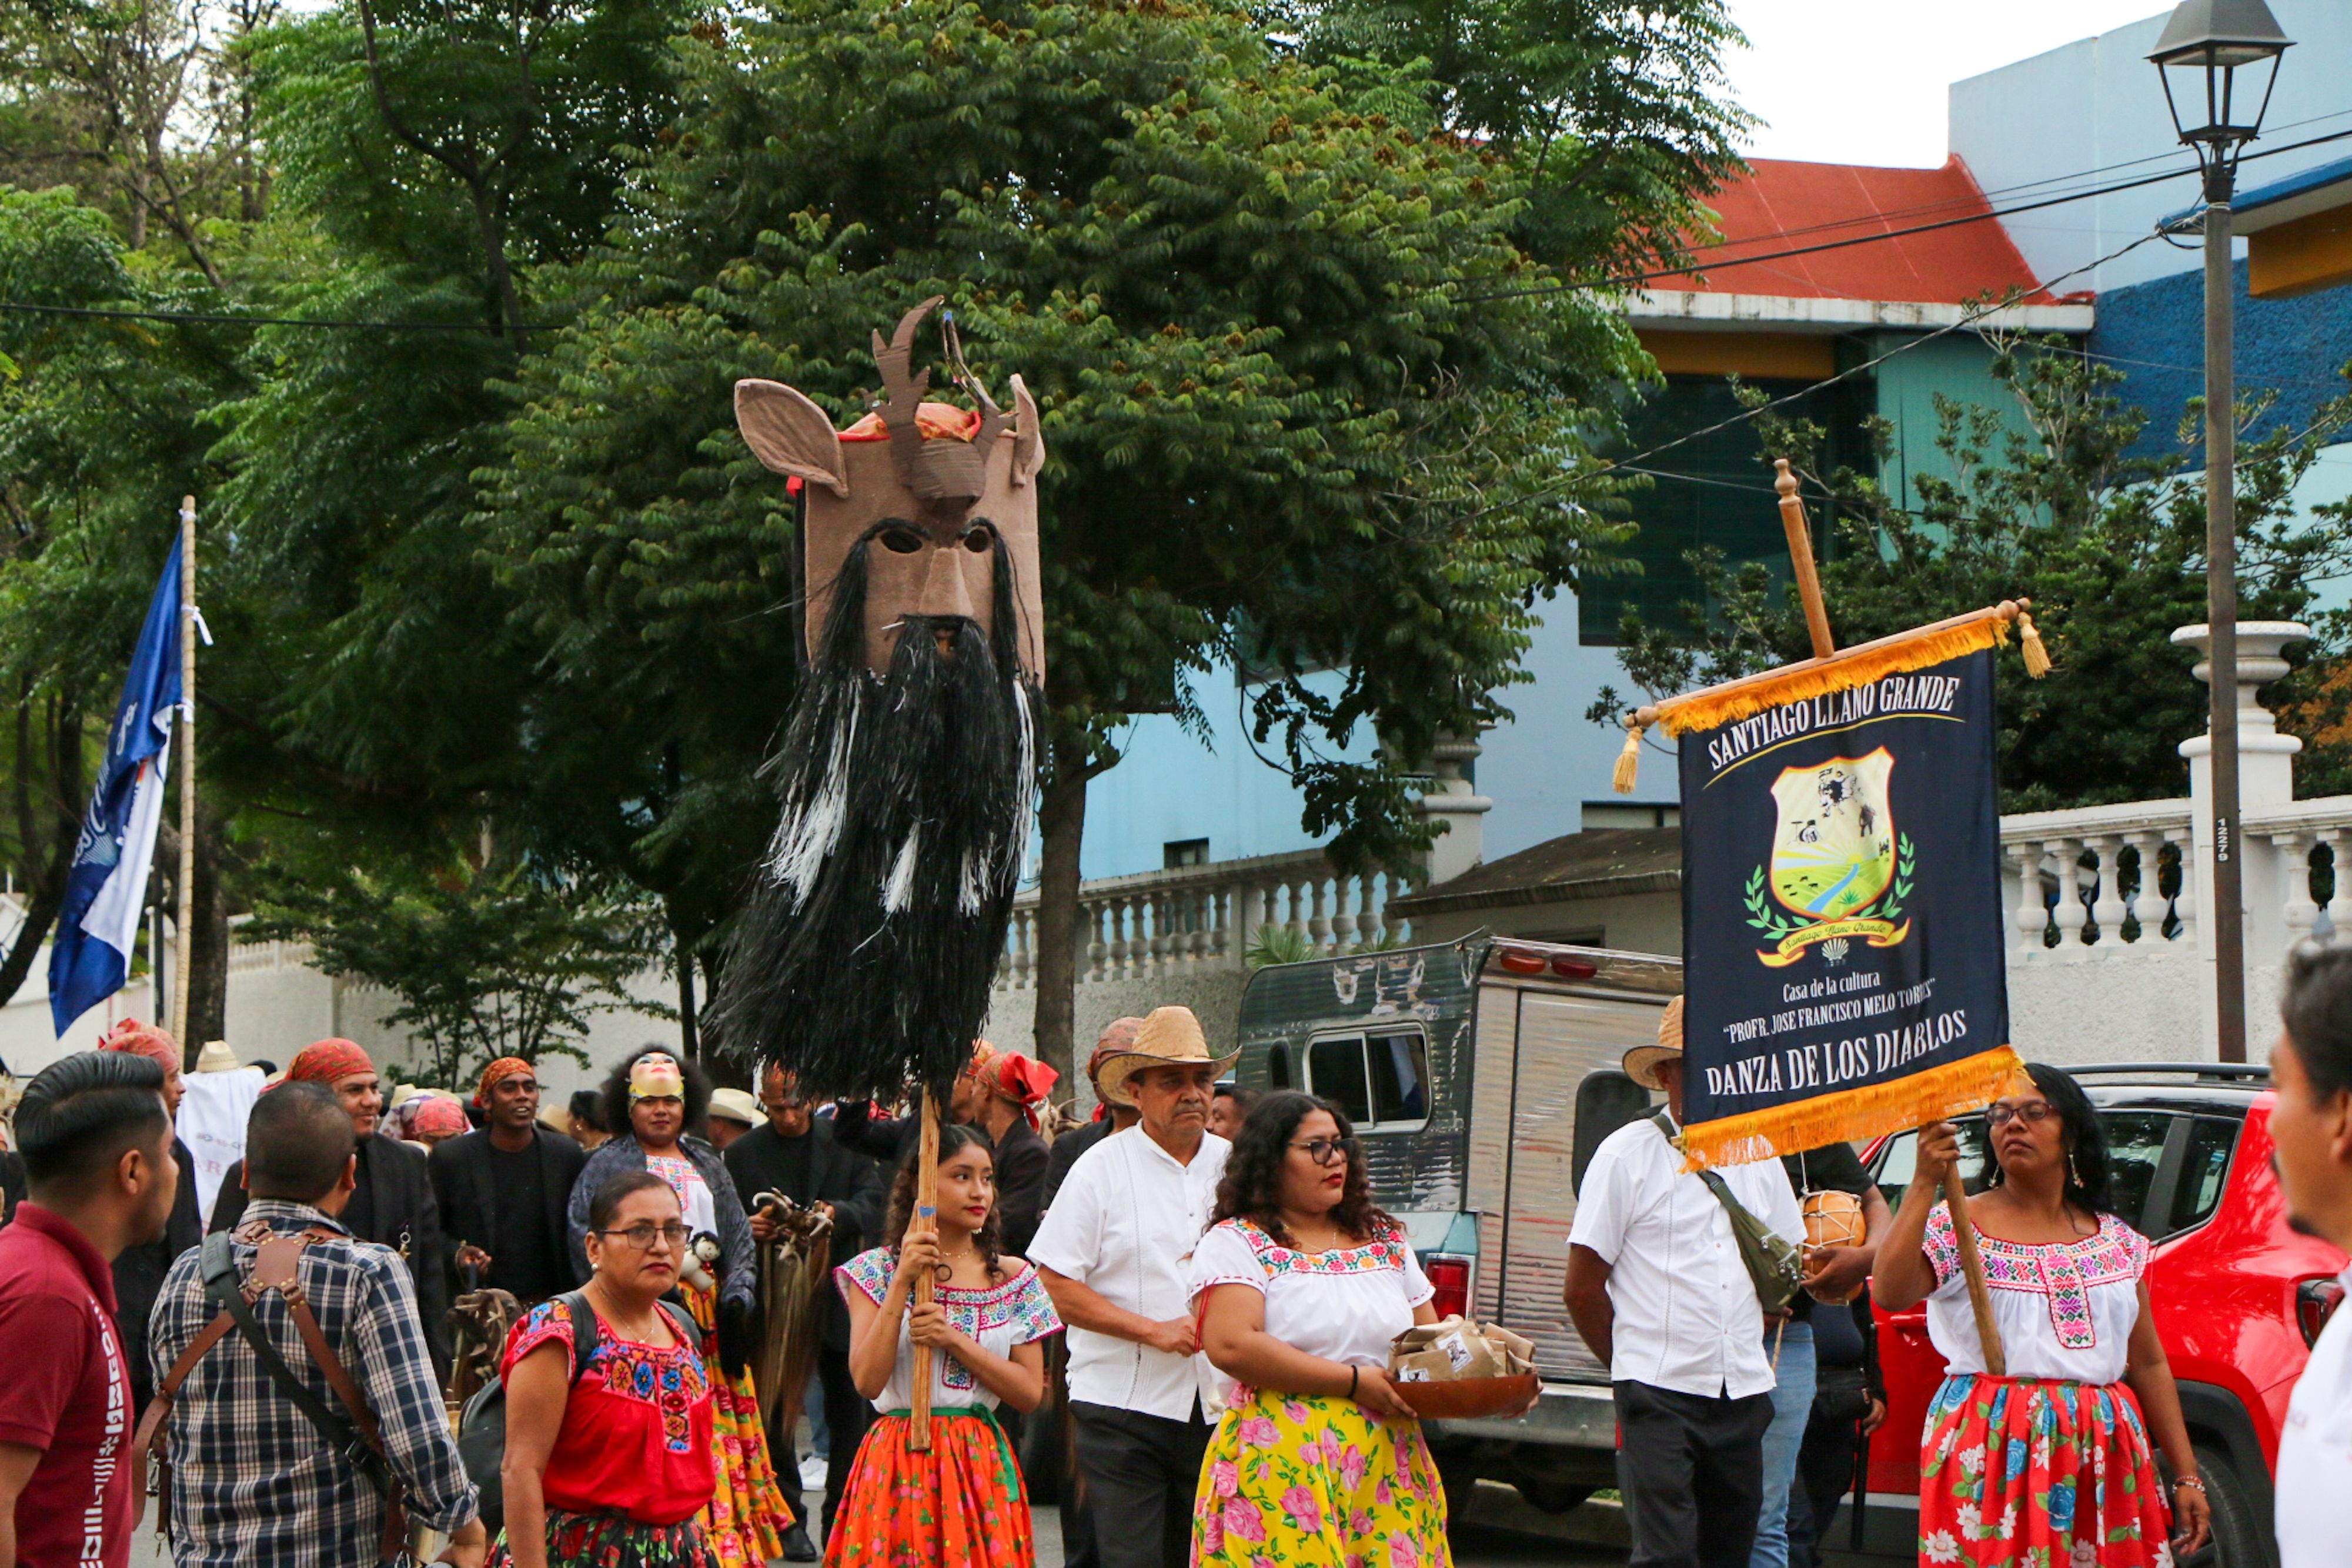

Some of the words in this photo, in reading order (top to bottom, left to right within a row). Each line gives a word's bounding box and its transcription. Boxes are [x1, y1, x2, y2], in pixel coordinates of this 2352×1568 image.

[1708, 700, 1809, 771] SANTIAGO
[1813, 682, 1876, 728] LLANO
[1879, 676, 1960, 713] GRANDE
[2217, 817, 2229, 862] 12279
[1782, 982, 1809, 1003] Casa
[1810, 978, 1825, 998] de
[1825, 975, 1837, 996] la
[1839, 971, 1881, 993] cultura
[1770, 1009, 1797, 1035] JOSE
[1797, 999, 1862, 1029] FRANCISCO
[1863, 992, 1896, 1018] MELO
[1705, 1053, 1783, 1095] DANZA
[1786, 1044, 1820, 1091] DE
[1823, 1036, 1870, 1085] LOS
[1874, 1009, 1968, 1074] DIABLOS
